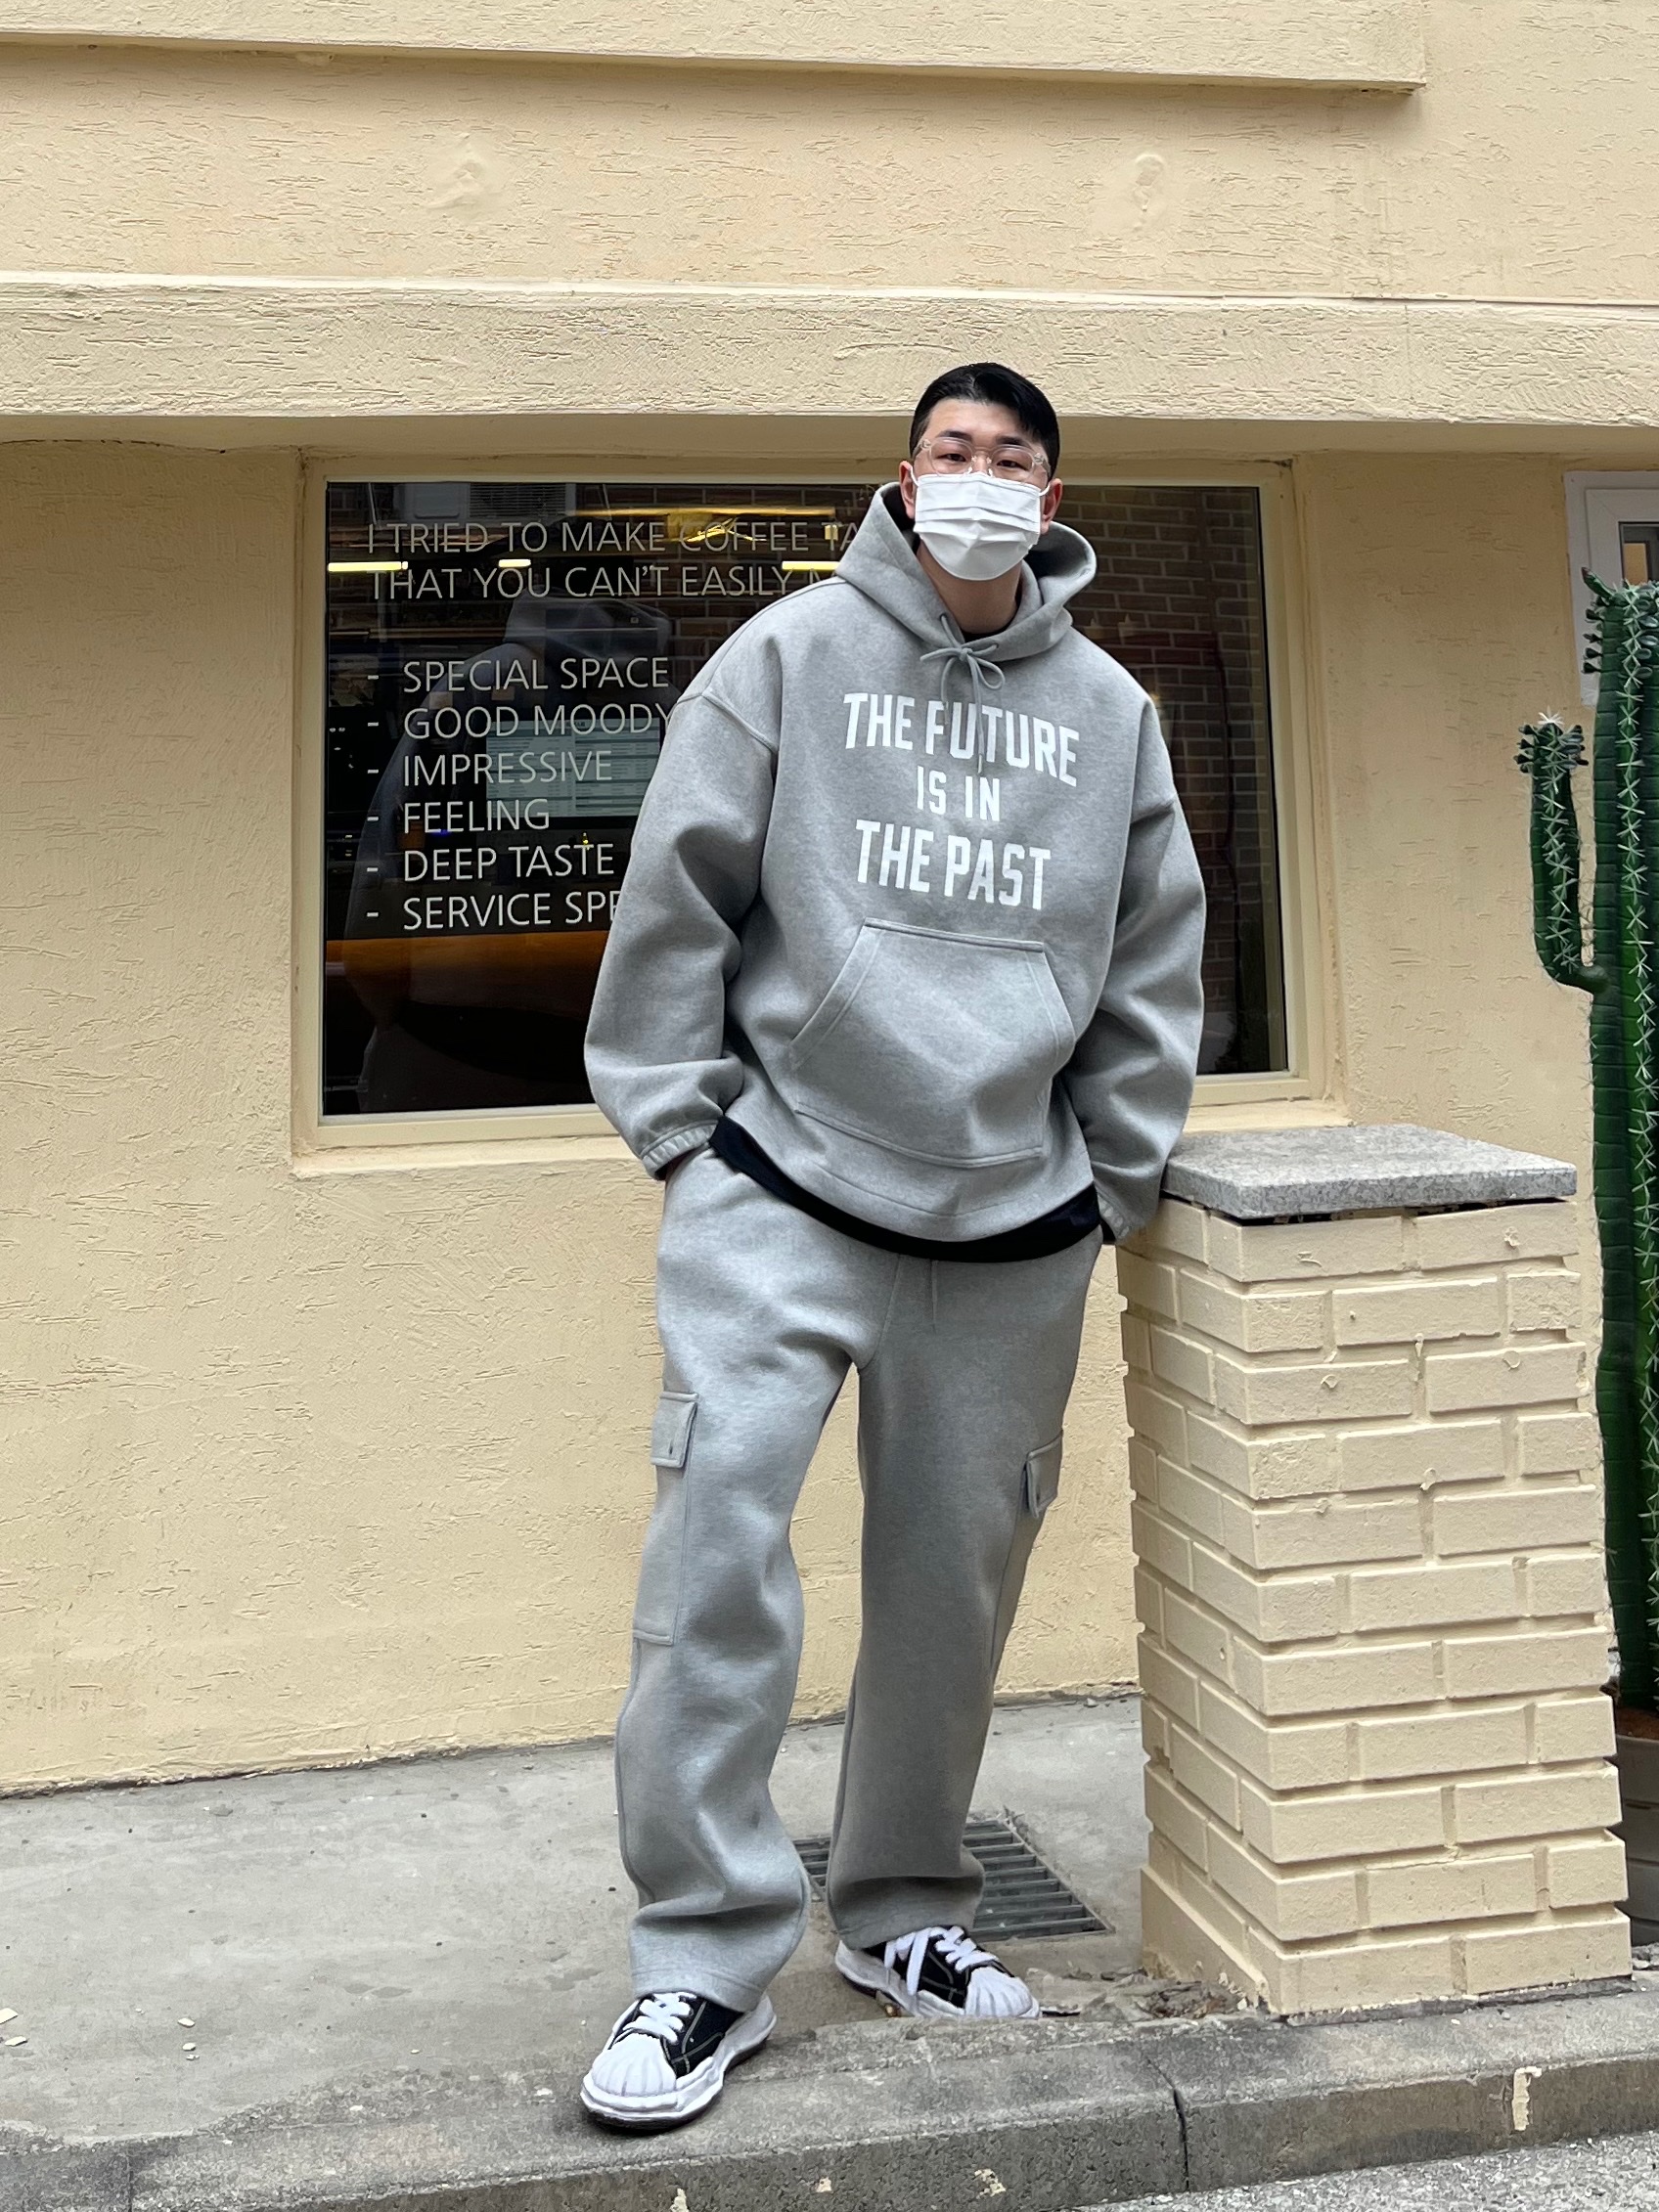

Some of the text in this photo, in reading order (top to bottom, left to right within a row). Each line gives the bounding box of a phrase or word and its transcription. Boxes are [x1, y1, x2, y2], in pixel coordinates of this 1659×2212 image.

[368, 523, 375, 553] I
[386, 522, 488, 553] TRIED
[501, 521, 548, 553] TO
[561, 521, 666, 552] MAKE
[680, 521, 809, 552] COFFEE
[367, 568, 463, 599] THAT
[473, 567, 550, 597] YOU
[564, 565, 670, 597] CAN'T
[682, 565, 793, 597] EASILY
[404, 659, 548, 692] SPECIAL
[560, 657, 669, 689] SPACE
[404, 707, 518, 739] GOOD
[534, 703, 674, 735] MOODY
[843, 692, 1080, 787] THE FUTURE
[404, 750, 612, 786] IMPRESSIVE
[917, 765, 1001, 821] IS IN
[404, 798, 550, 833] FEELING
[404, 847, 497, 881] DEEP
[509, 843, 614, 877] TASTE
[855, 818, 1052, 910] THE PAST
[403, 893, 552, 930] SERVICE
